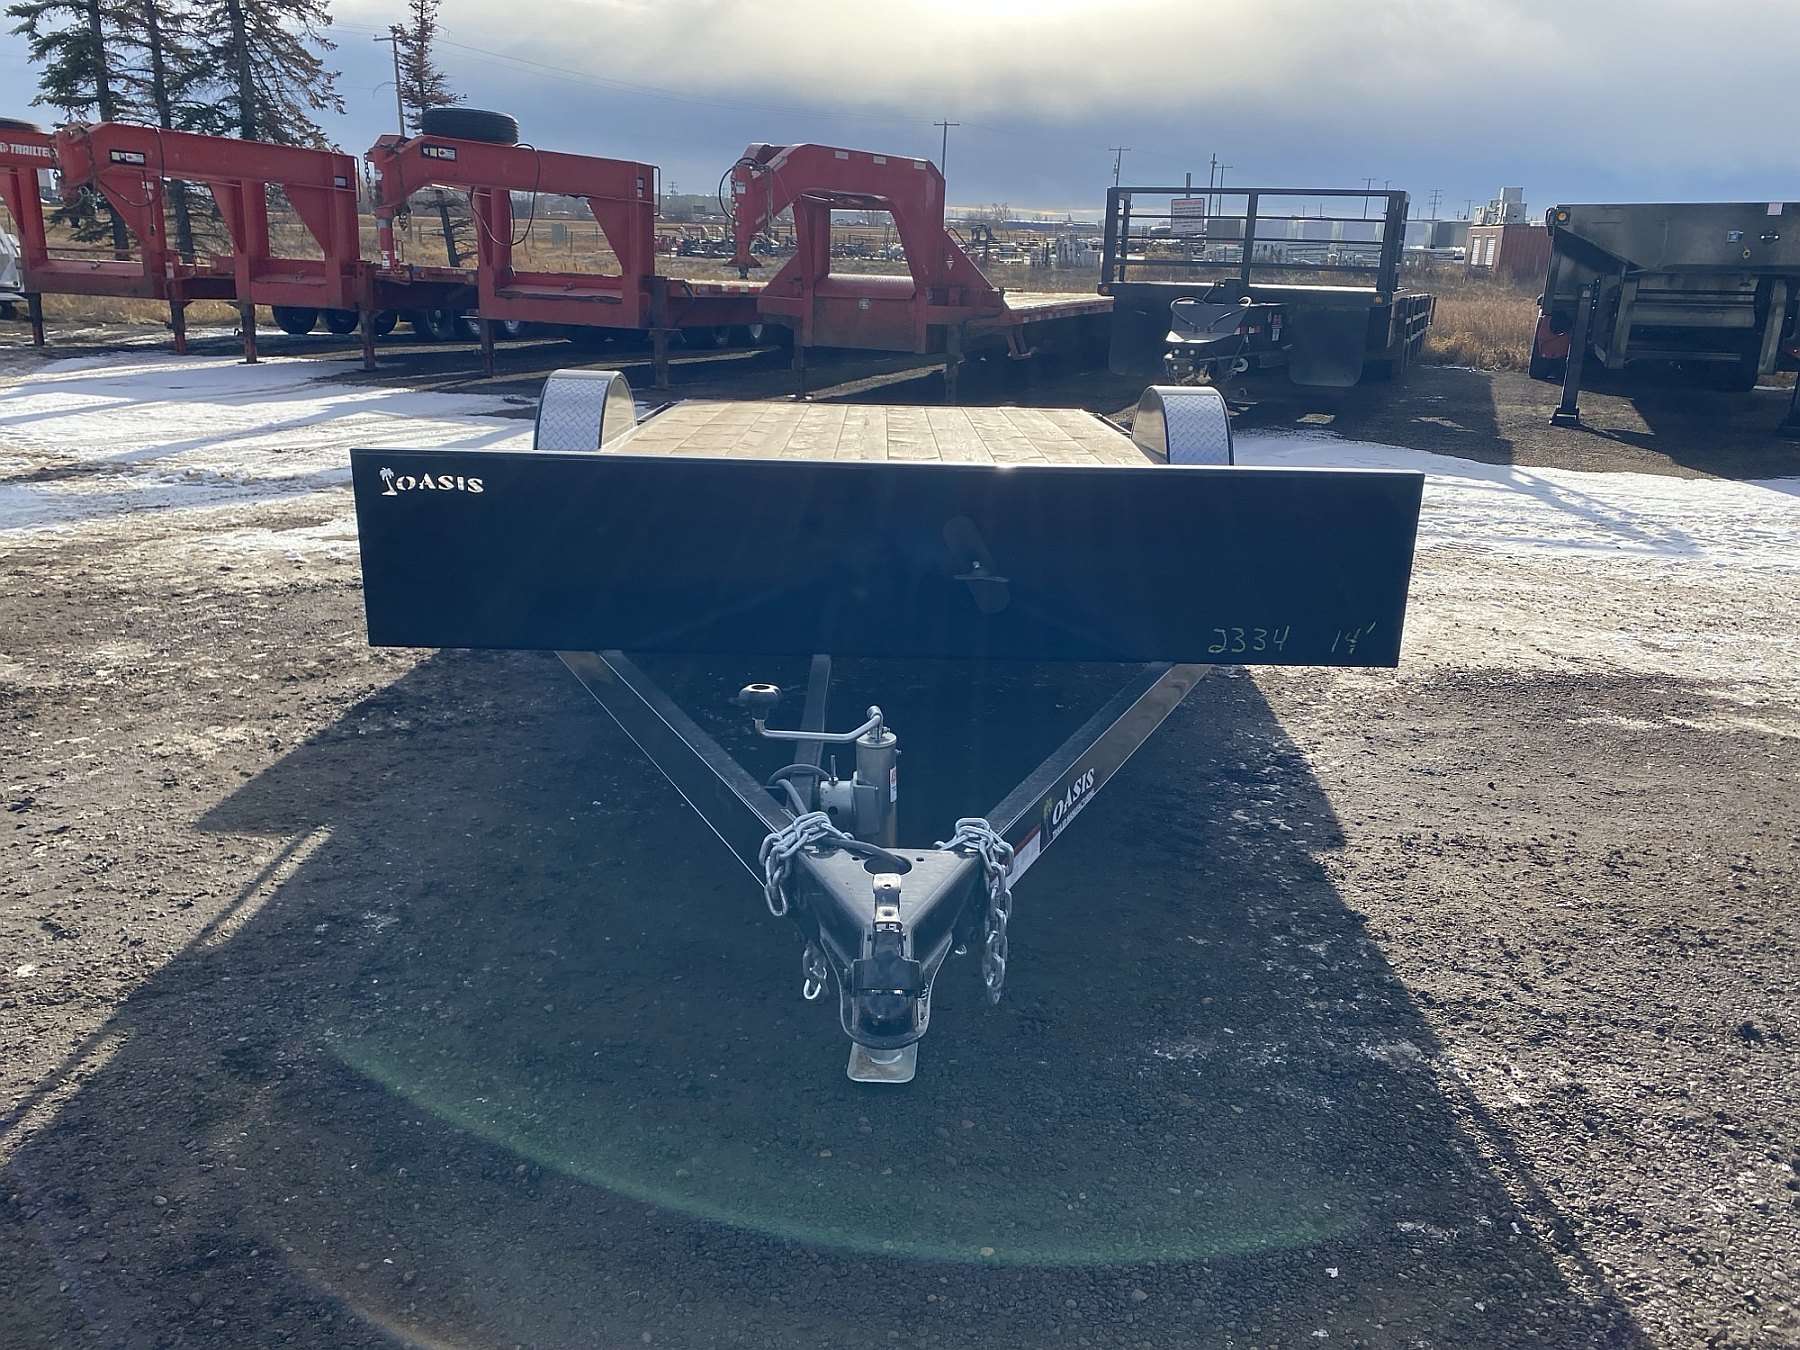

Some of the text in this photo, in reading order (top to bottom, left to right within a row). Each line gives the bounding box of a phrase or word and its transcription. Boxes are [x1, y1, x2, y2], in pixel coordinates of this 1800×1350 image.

[10, 143, 51, 158] TRAILTE
[395, 473, 484, 494] OASIS
[1208, 625, 1290, 653] 2334
[1052, 767, 1095, 825] OASIS
